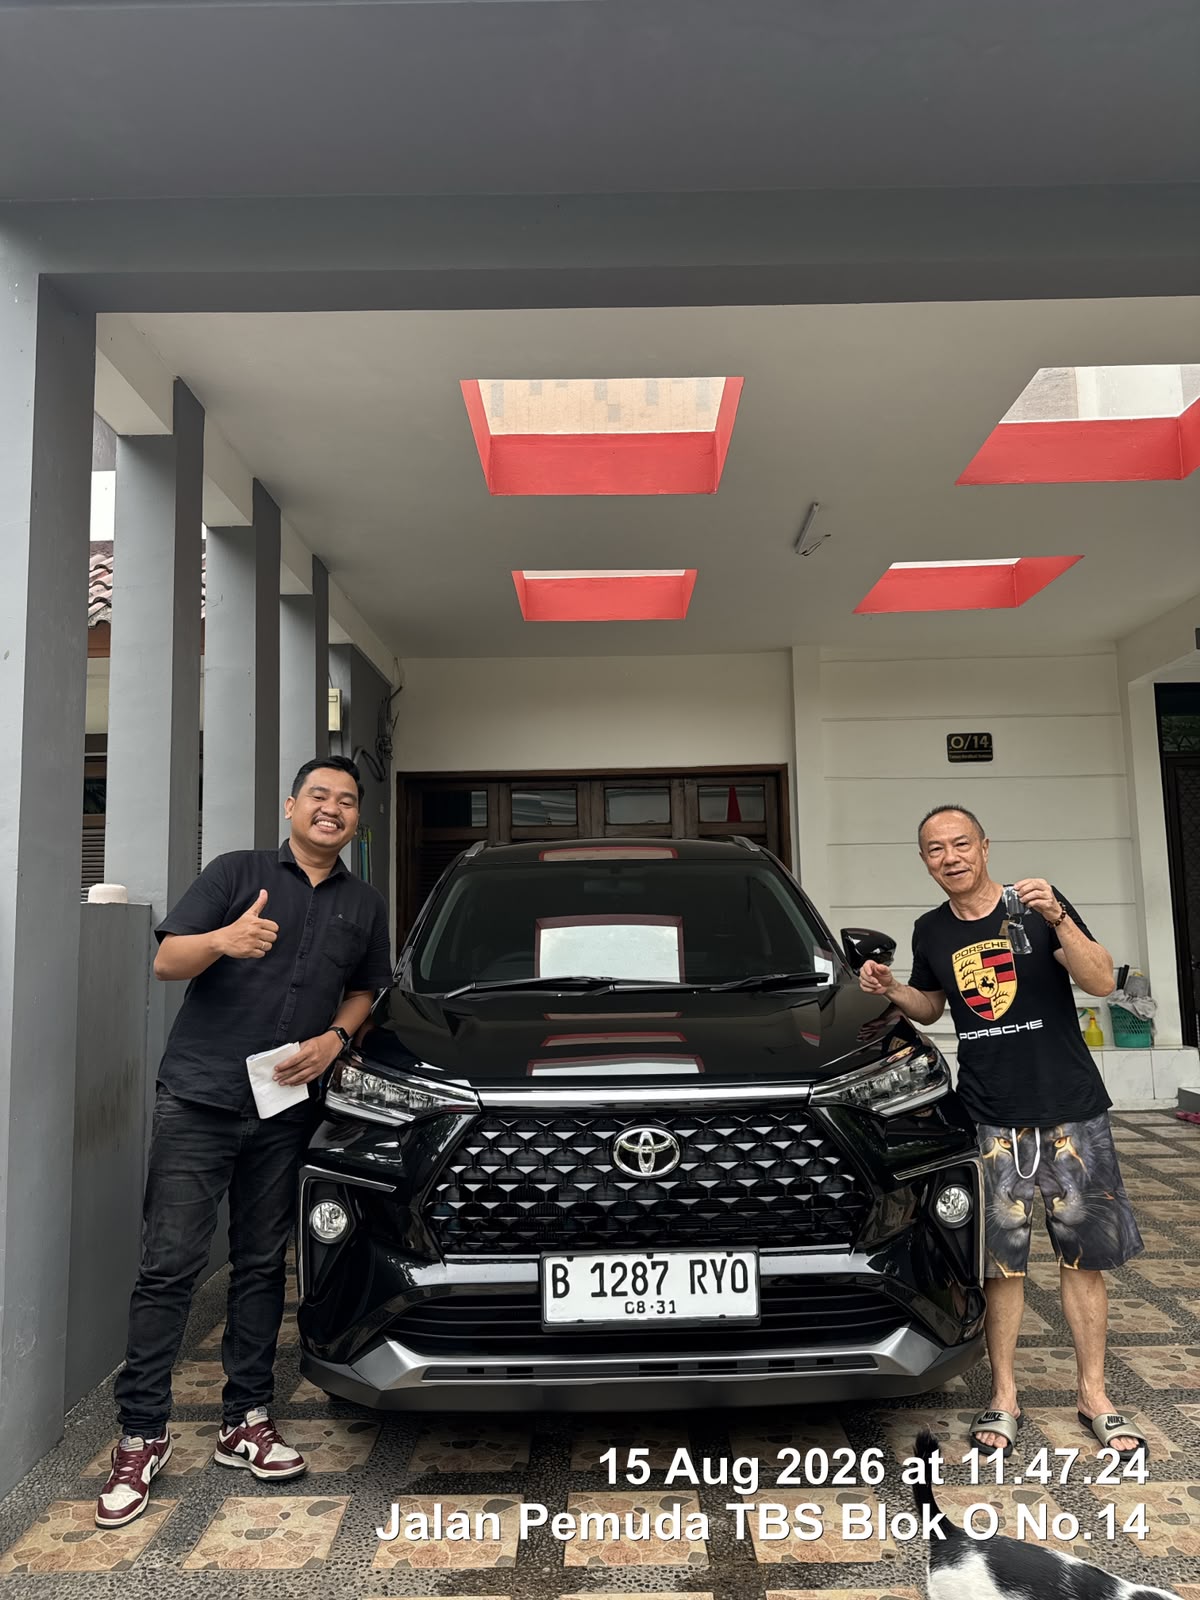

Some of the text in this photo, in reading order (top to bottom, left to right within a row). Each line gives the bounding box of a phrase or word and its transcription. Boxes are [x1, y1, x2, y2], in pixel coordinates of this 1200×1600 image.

[954, 941, 1008, 961] PORSCHE
[959, 1019, 1044, 1040] PORSCHE
[551, 1258, 748, 1299] B 1287 RYO
[982, 1411, 1004, 1420] NIKE
[1106, 1415, 1125, 1424] NIKE
